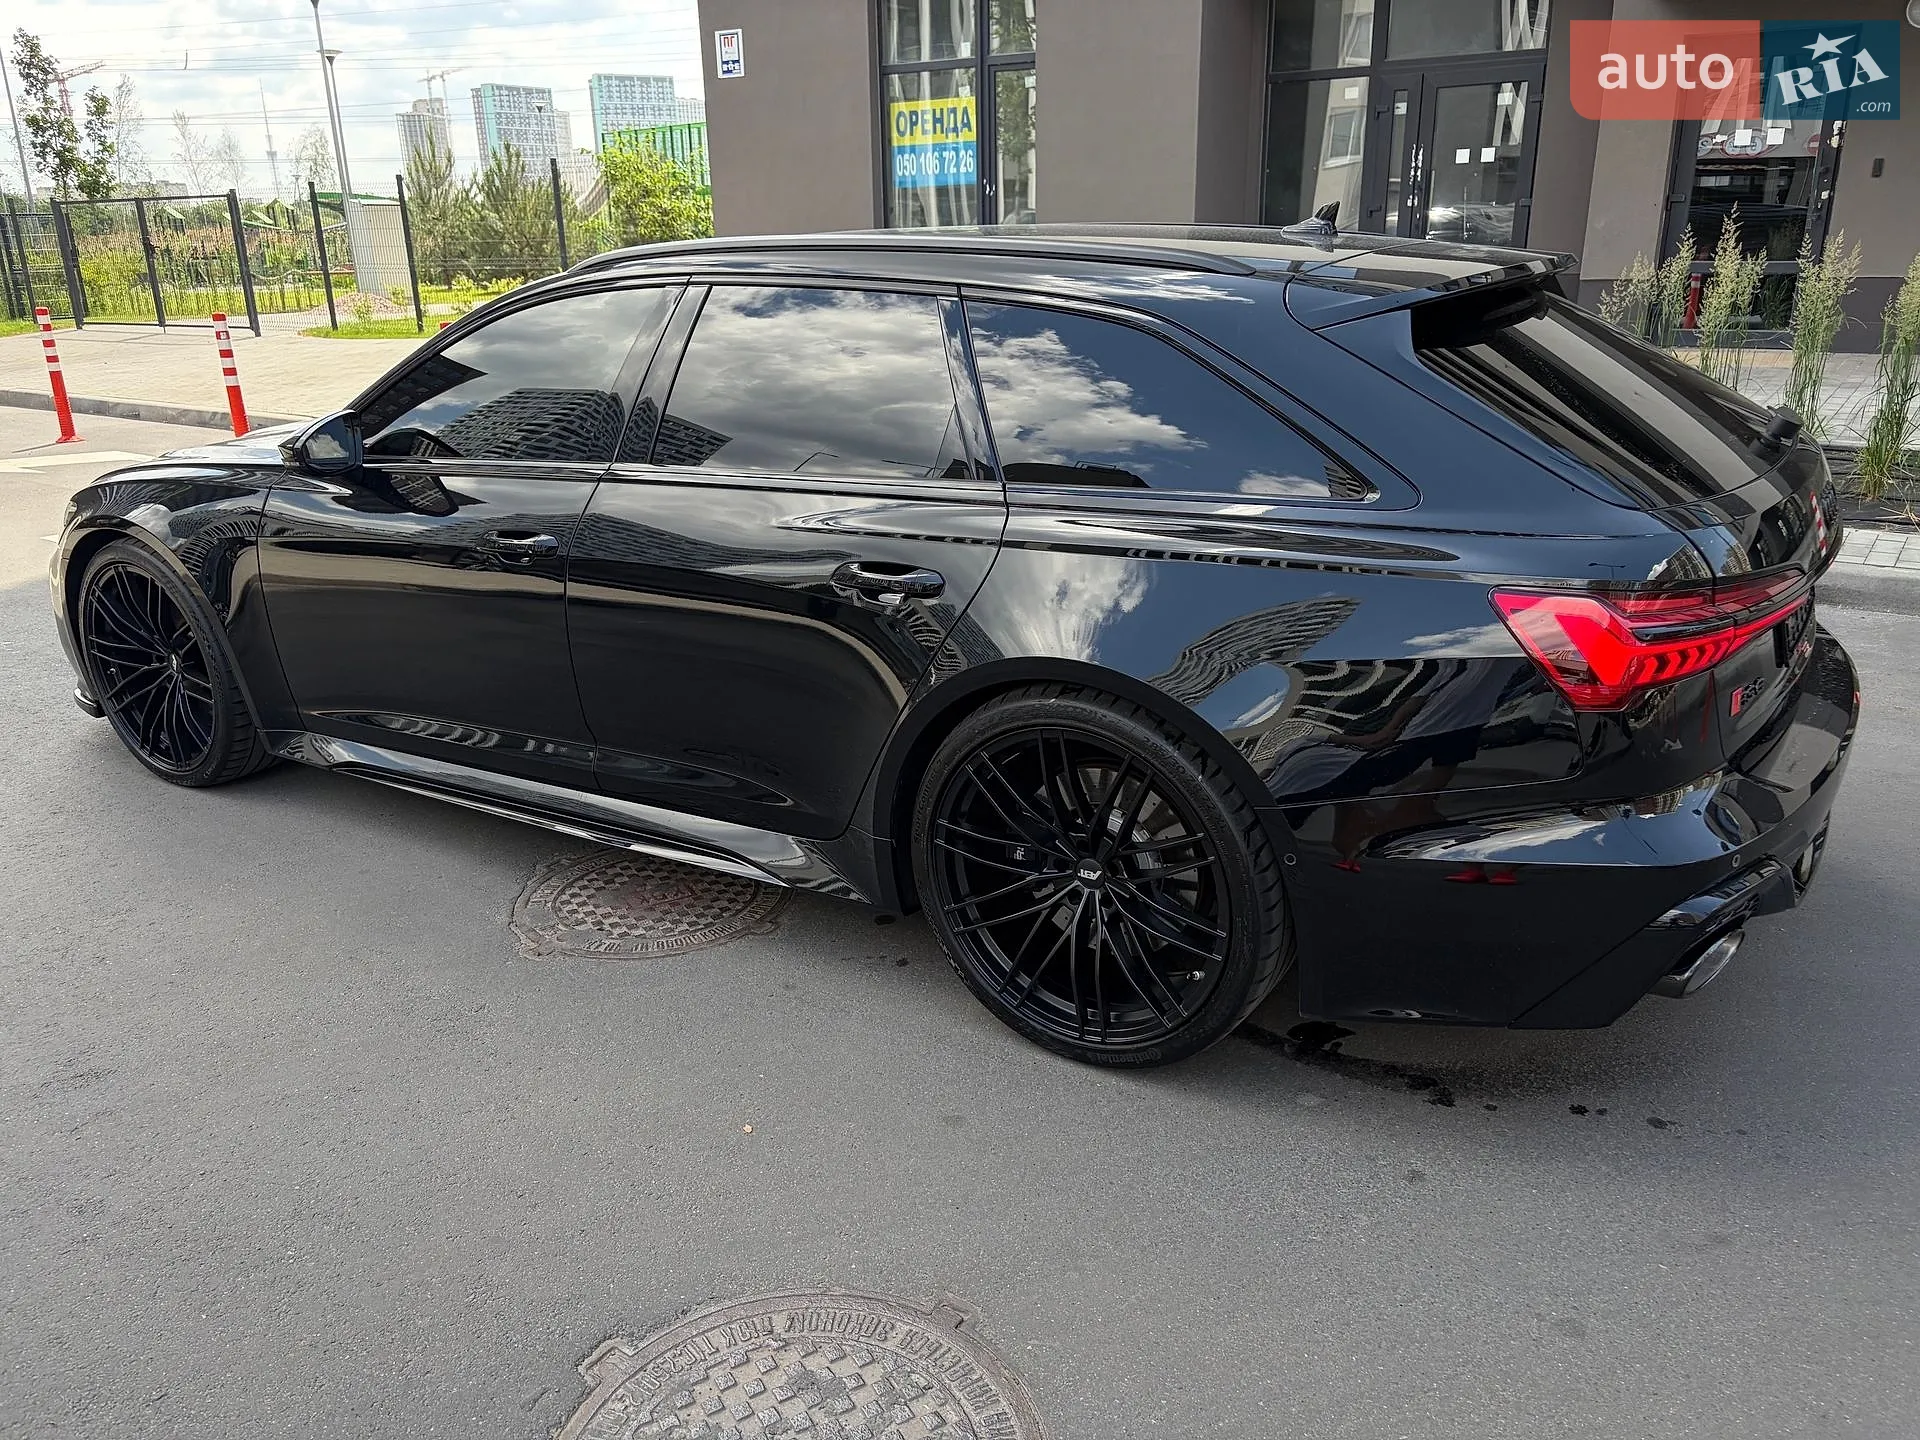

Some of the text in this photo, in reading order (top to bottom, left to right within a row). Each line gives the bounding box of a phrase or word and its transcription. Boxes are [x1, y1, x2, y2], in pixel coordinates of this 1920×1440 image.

[895, 105, 972, 139] ОРЕНДА
[896, 149, 974, 176] 050 106 72 26
[784, 1310, 894, 1342] ЗАКОНОМ
